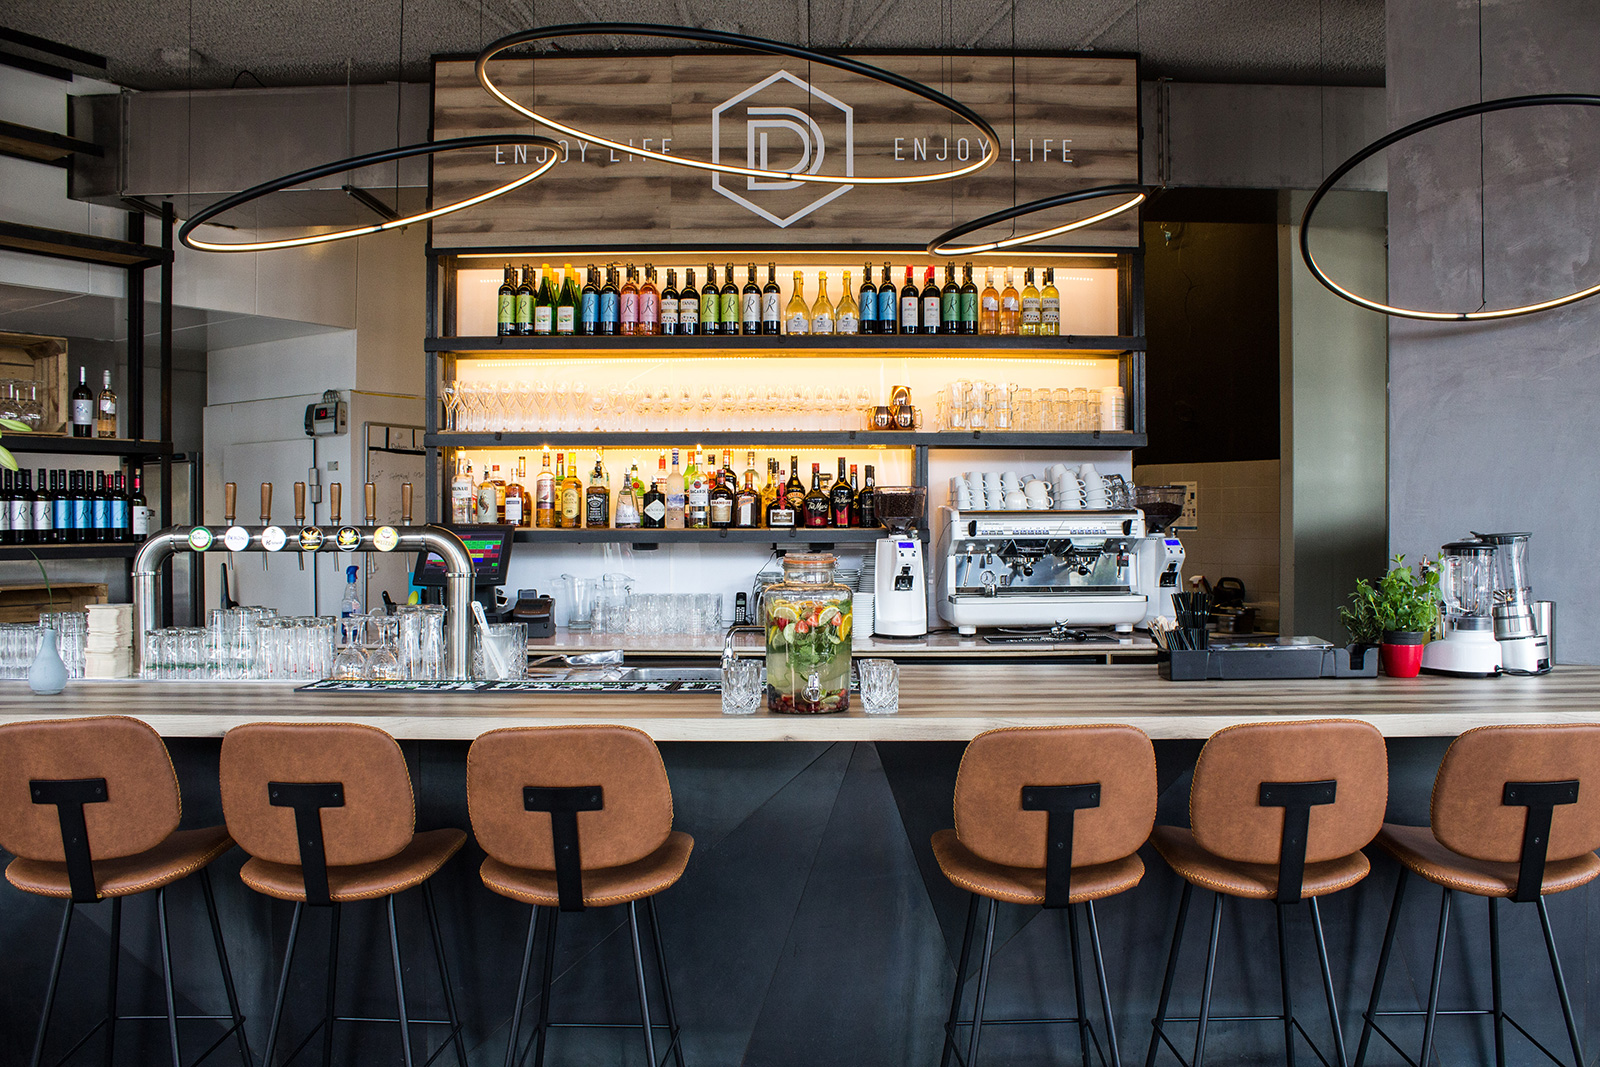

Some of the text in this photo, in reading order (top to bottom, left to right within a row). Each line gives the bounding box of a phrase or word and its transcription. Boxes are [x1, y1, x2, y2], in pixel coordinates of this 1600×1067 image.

[495, 138, 590, 165] ENJOY
[894, 137, 1075, 163] ENJOY LIFE
